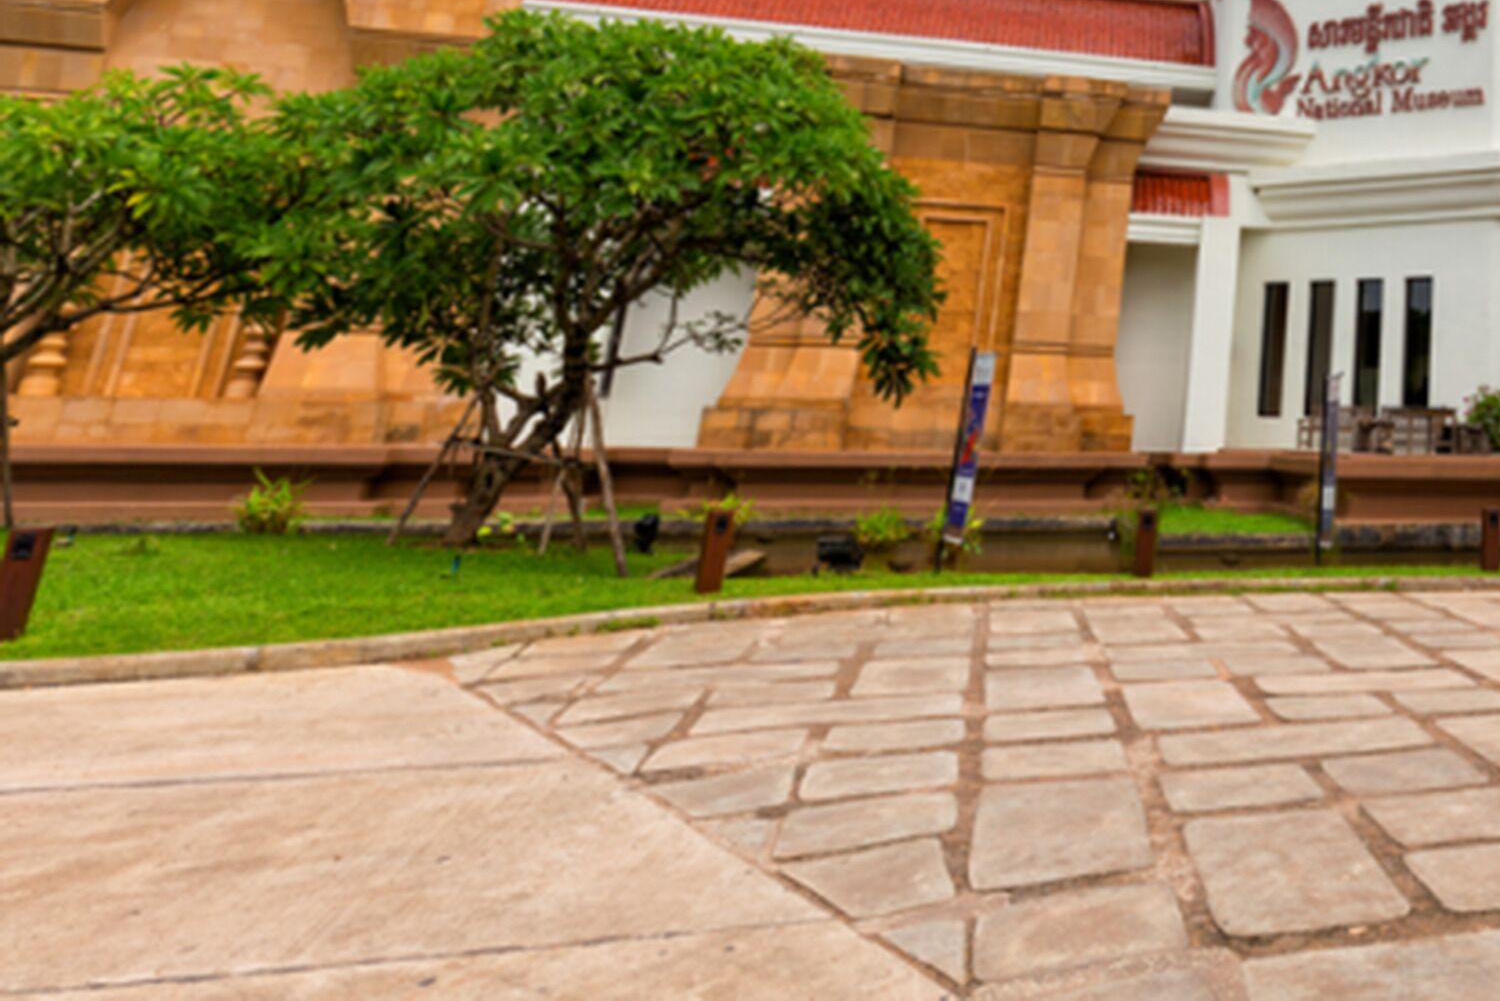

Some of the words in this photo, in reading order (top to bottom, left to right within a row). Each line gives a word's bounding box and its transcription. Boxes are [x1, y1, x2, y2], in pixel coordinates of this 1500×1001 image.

[1301, 54, 1430, 98] Angkor
[1297, 90, 1382, 120] National
[1391, 87, 1486, 113] Museum
